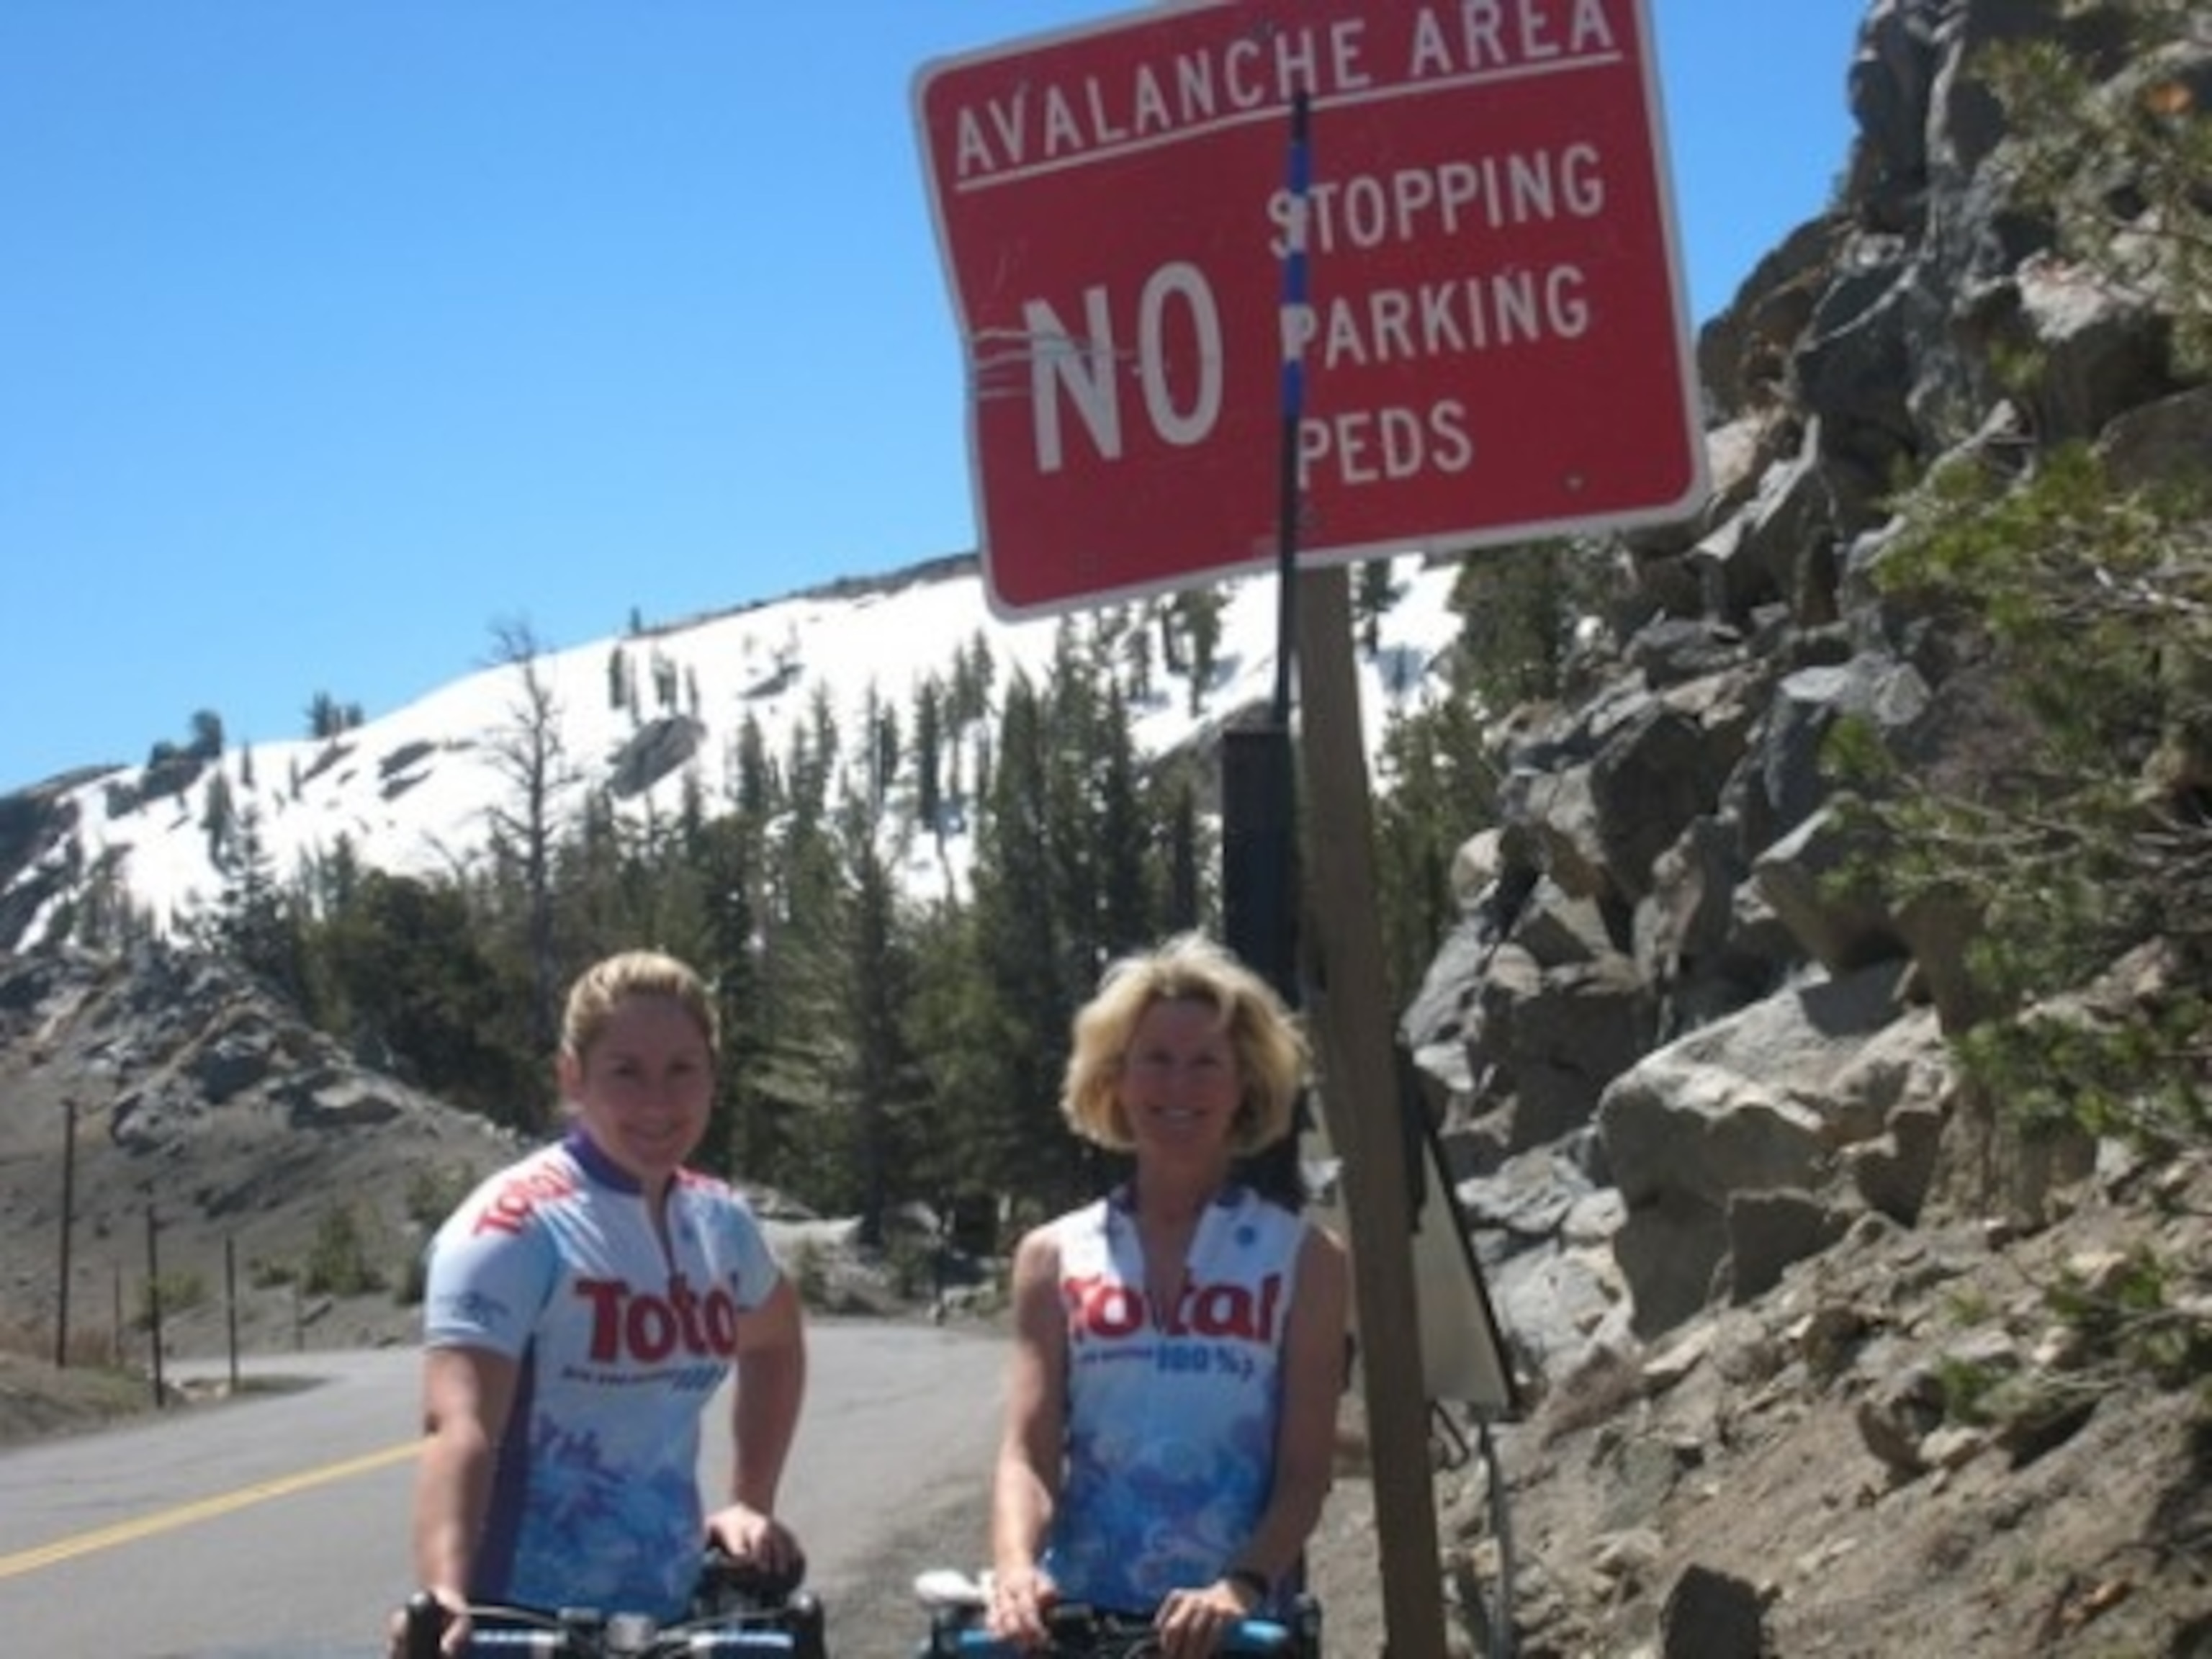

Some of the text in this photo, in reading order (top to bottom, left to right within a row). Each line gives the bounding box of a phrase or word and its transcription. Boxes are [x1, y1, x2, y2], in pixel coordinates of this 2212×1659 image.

[955, 0, 1616, 177] AVALANCHE AREA
[1266, 144, 1606, 260] STOPPING
[1020, 261, 1224, 473] NO
[1280, 264, 1589, 371] PARKING
[1296, 400, 1473, 491] PEDS
